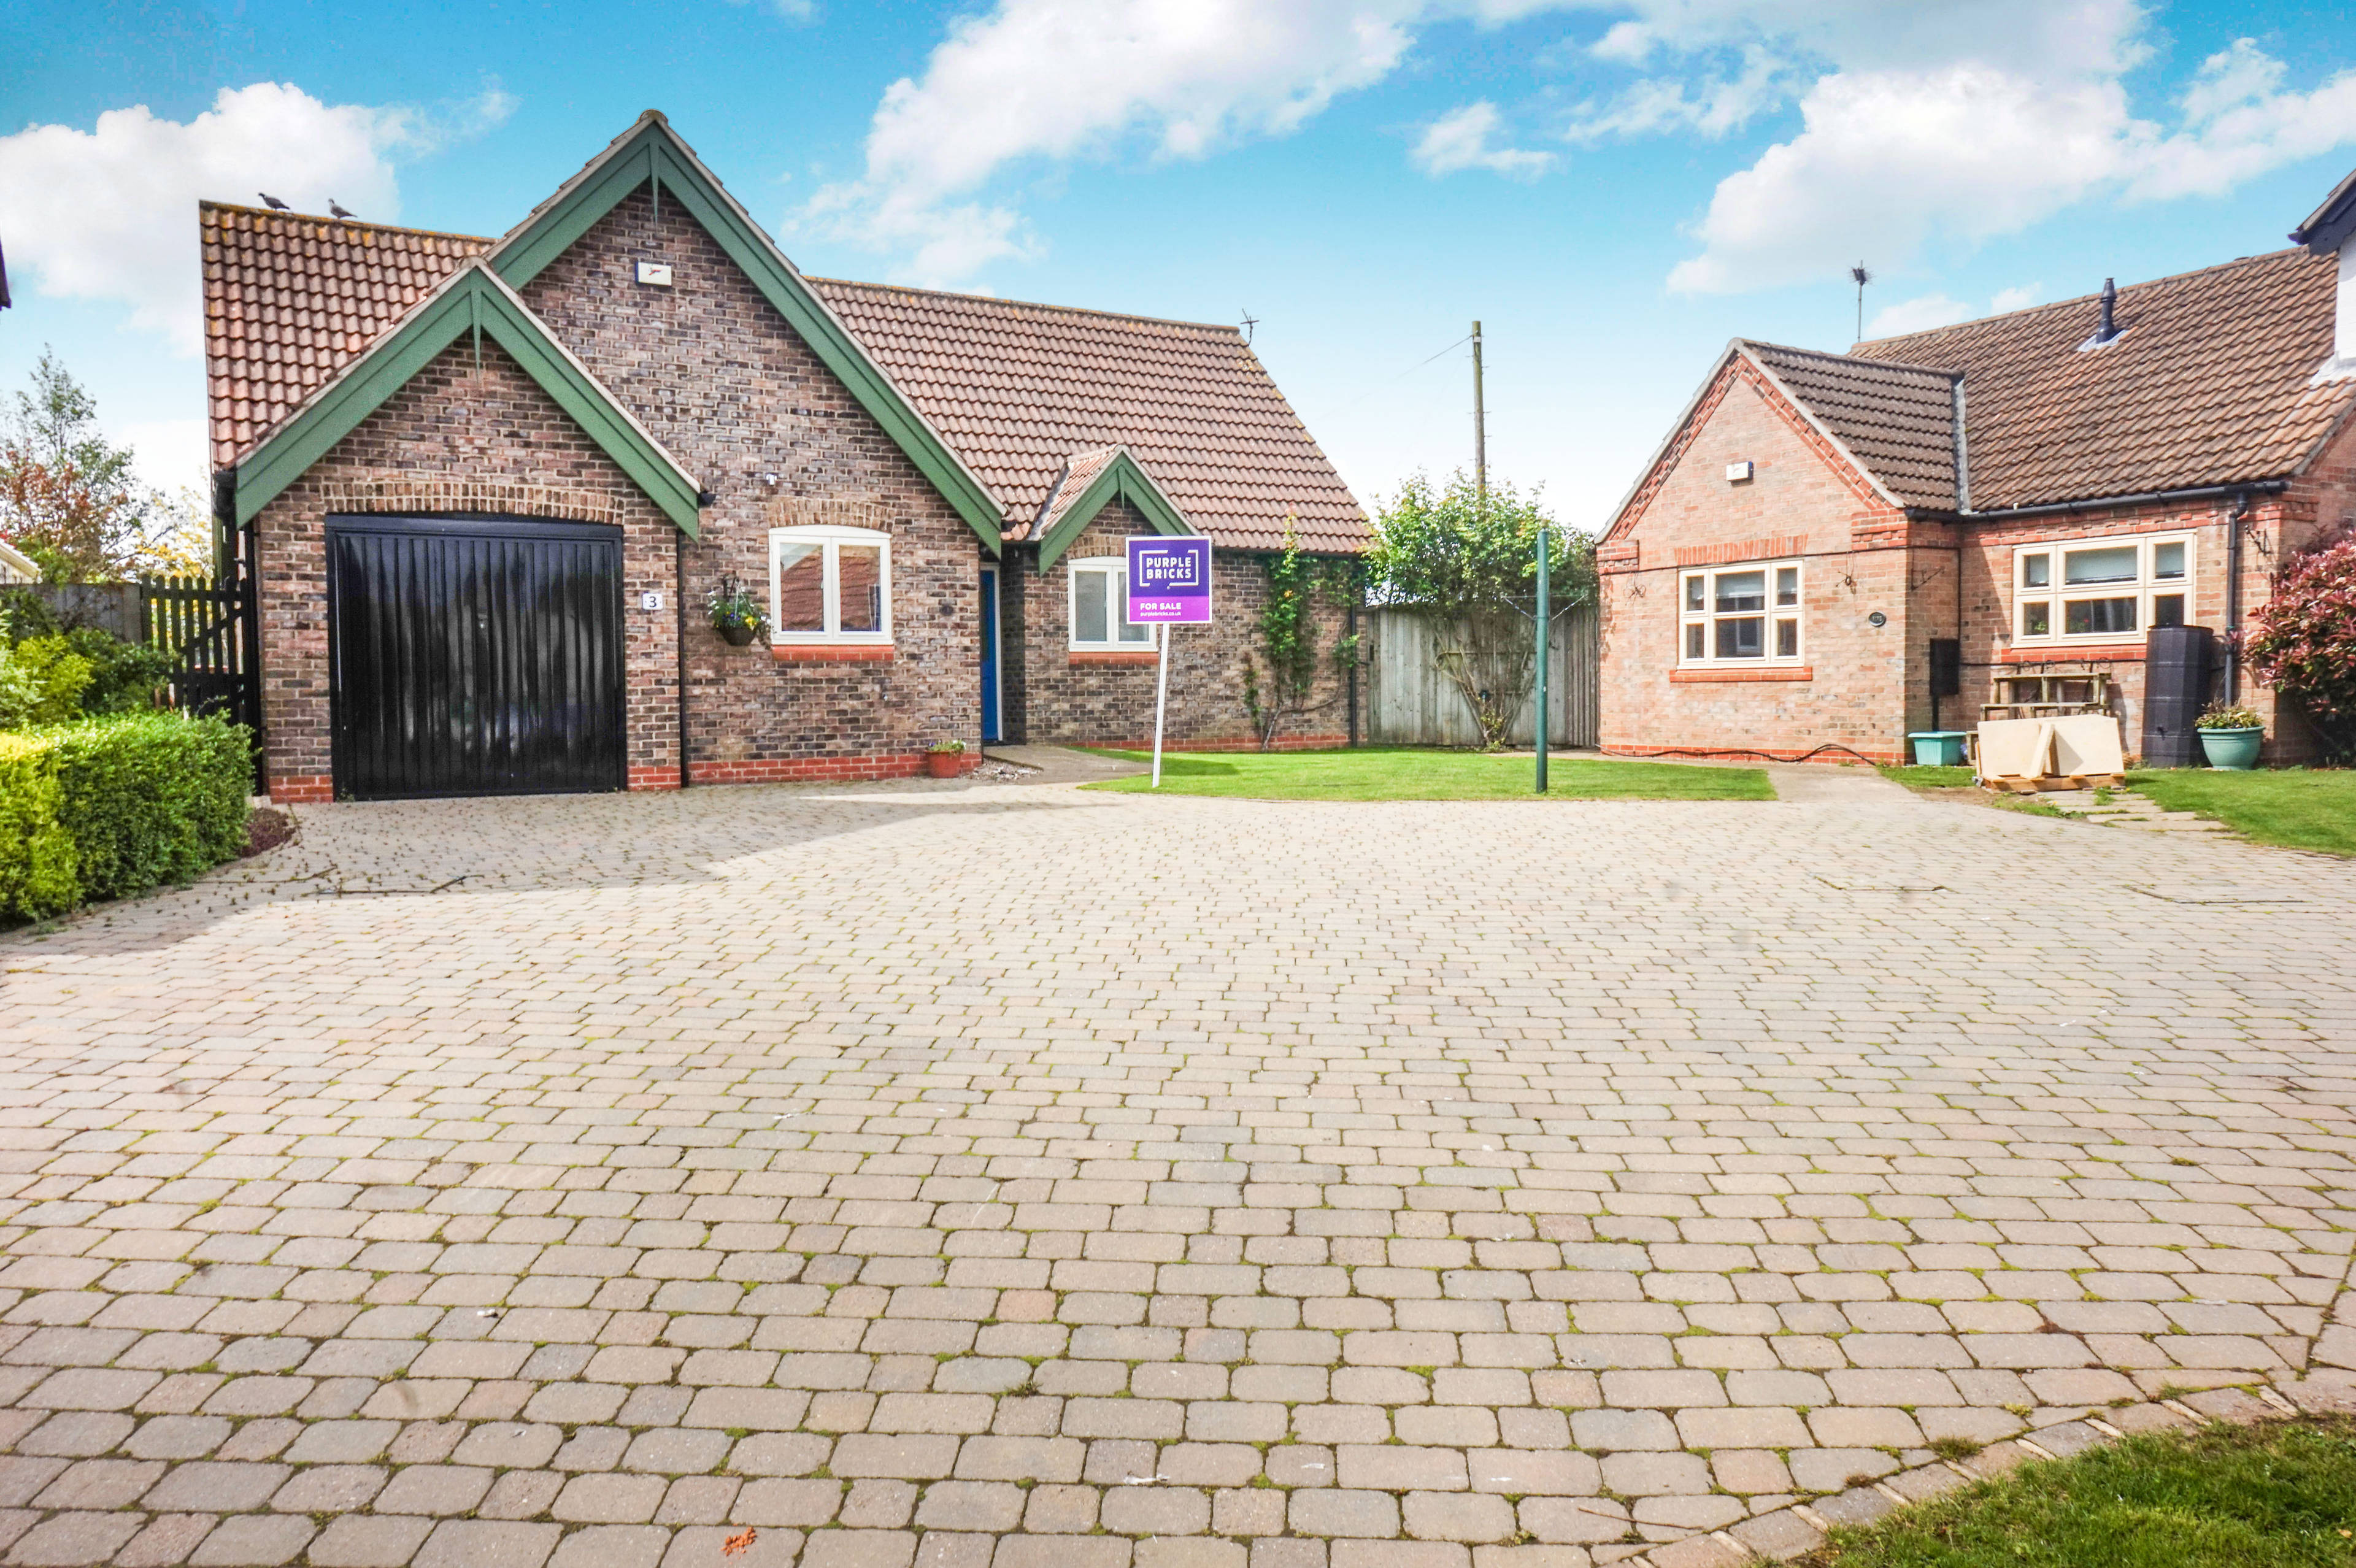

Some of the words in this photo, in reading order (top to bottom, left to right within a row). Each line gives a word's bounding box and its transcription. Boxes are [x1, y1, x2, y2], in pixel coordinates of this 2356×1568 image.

[1146, 557, 1191, 568] PURPLE
[1146, 569, 1191, 580] BRICKS
[649, 596, 656, 607] 3
